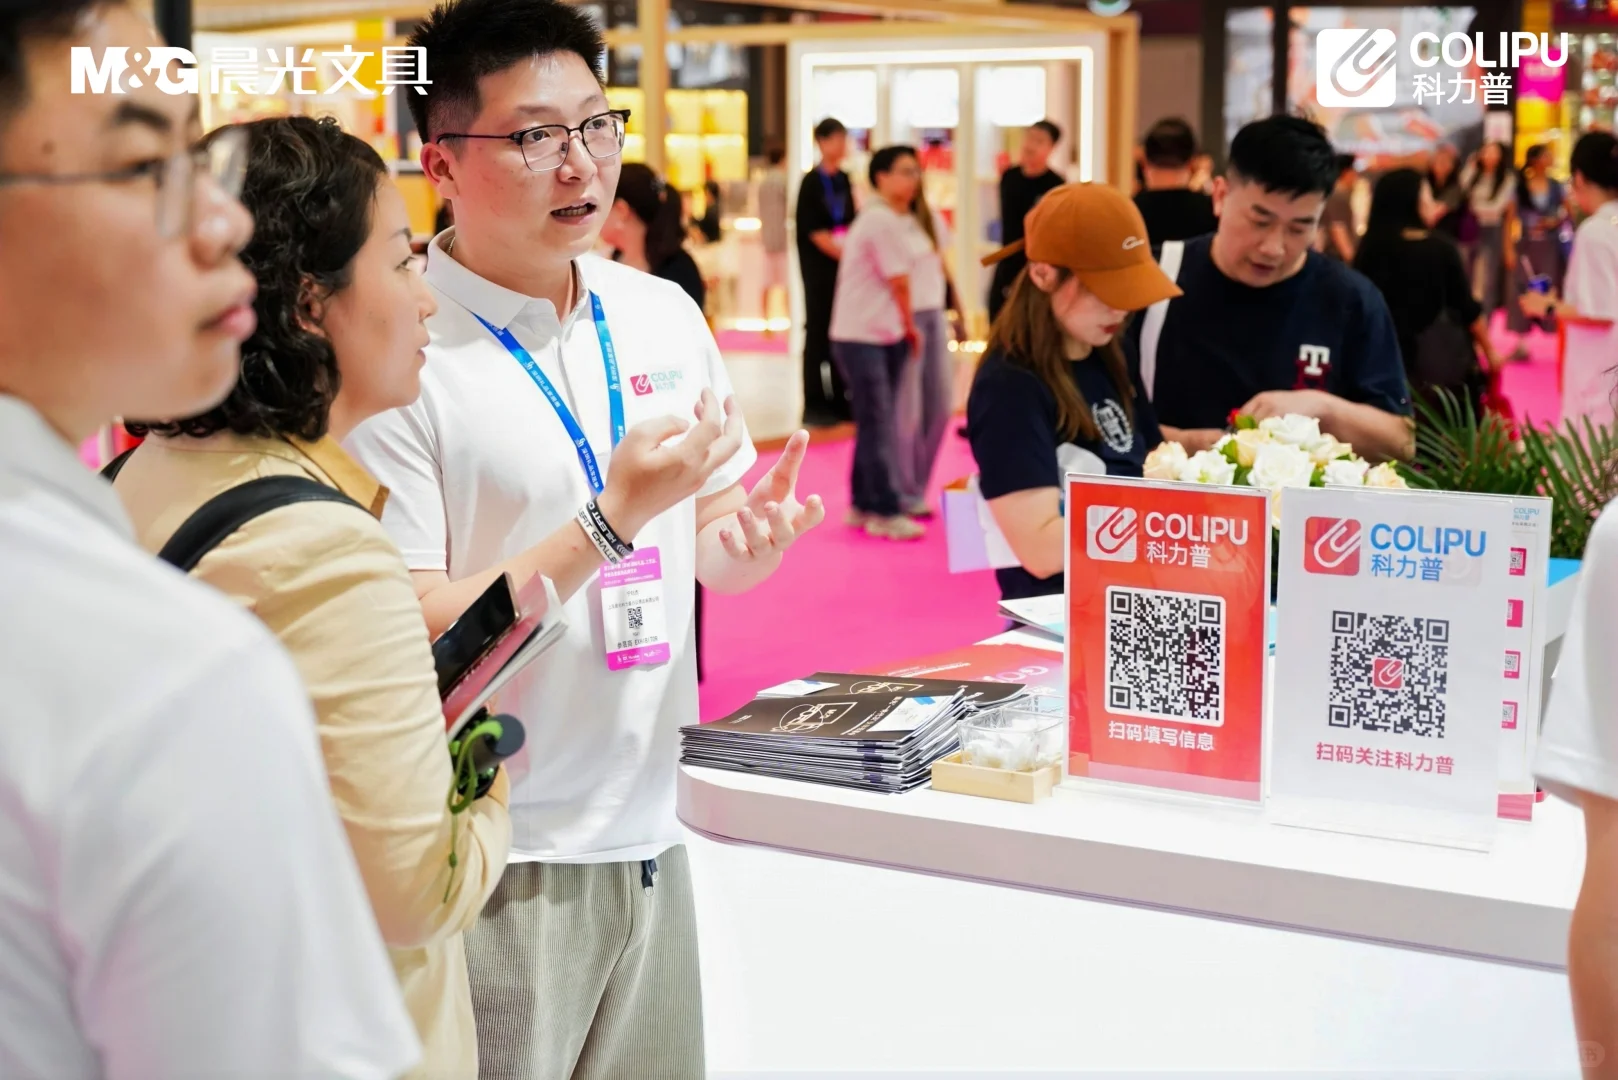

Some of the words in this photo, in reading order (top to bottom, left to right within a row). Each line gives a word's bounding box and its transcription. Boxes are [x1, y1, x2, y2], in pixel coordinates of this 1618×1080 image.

[1144, 511, 1249, 546] COLIPU
[1370, 523, 1487, 557] COLIPU
[1146, 541, 1212, 569] 科力普
[1371, 554, 1444, 582] 科力普
[1108, 720, 1215, 751] 扫码填写信息
[1315, 741, 1455, 775] 扫码关注科力普
